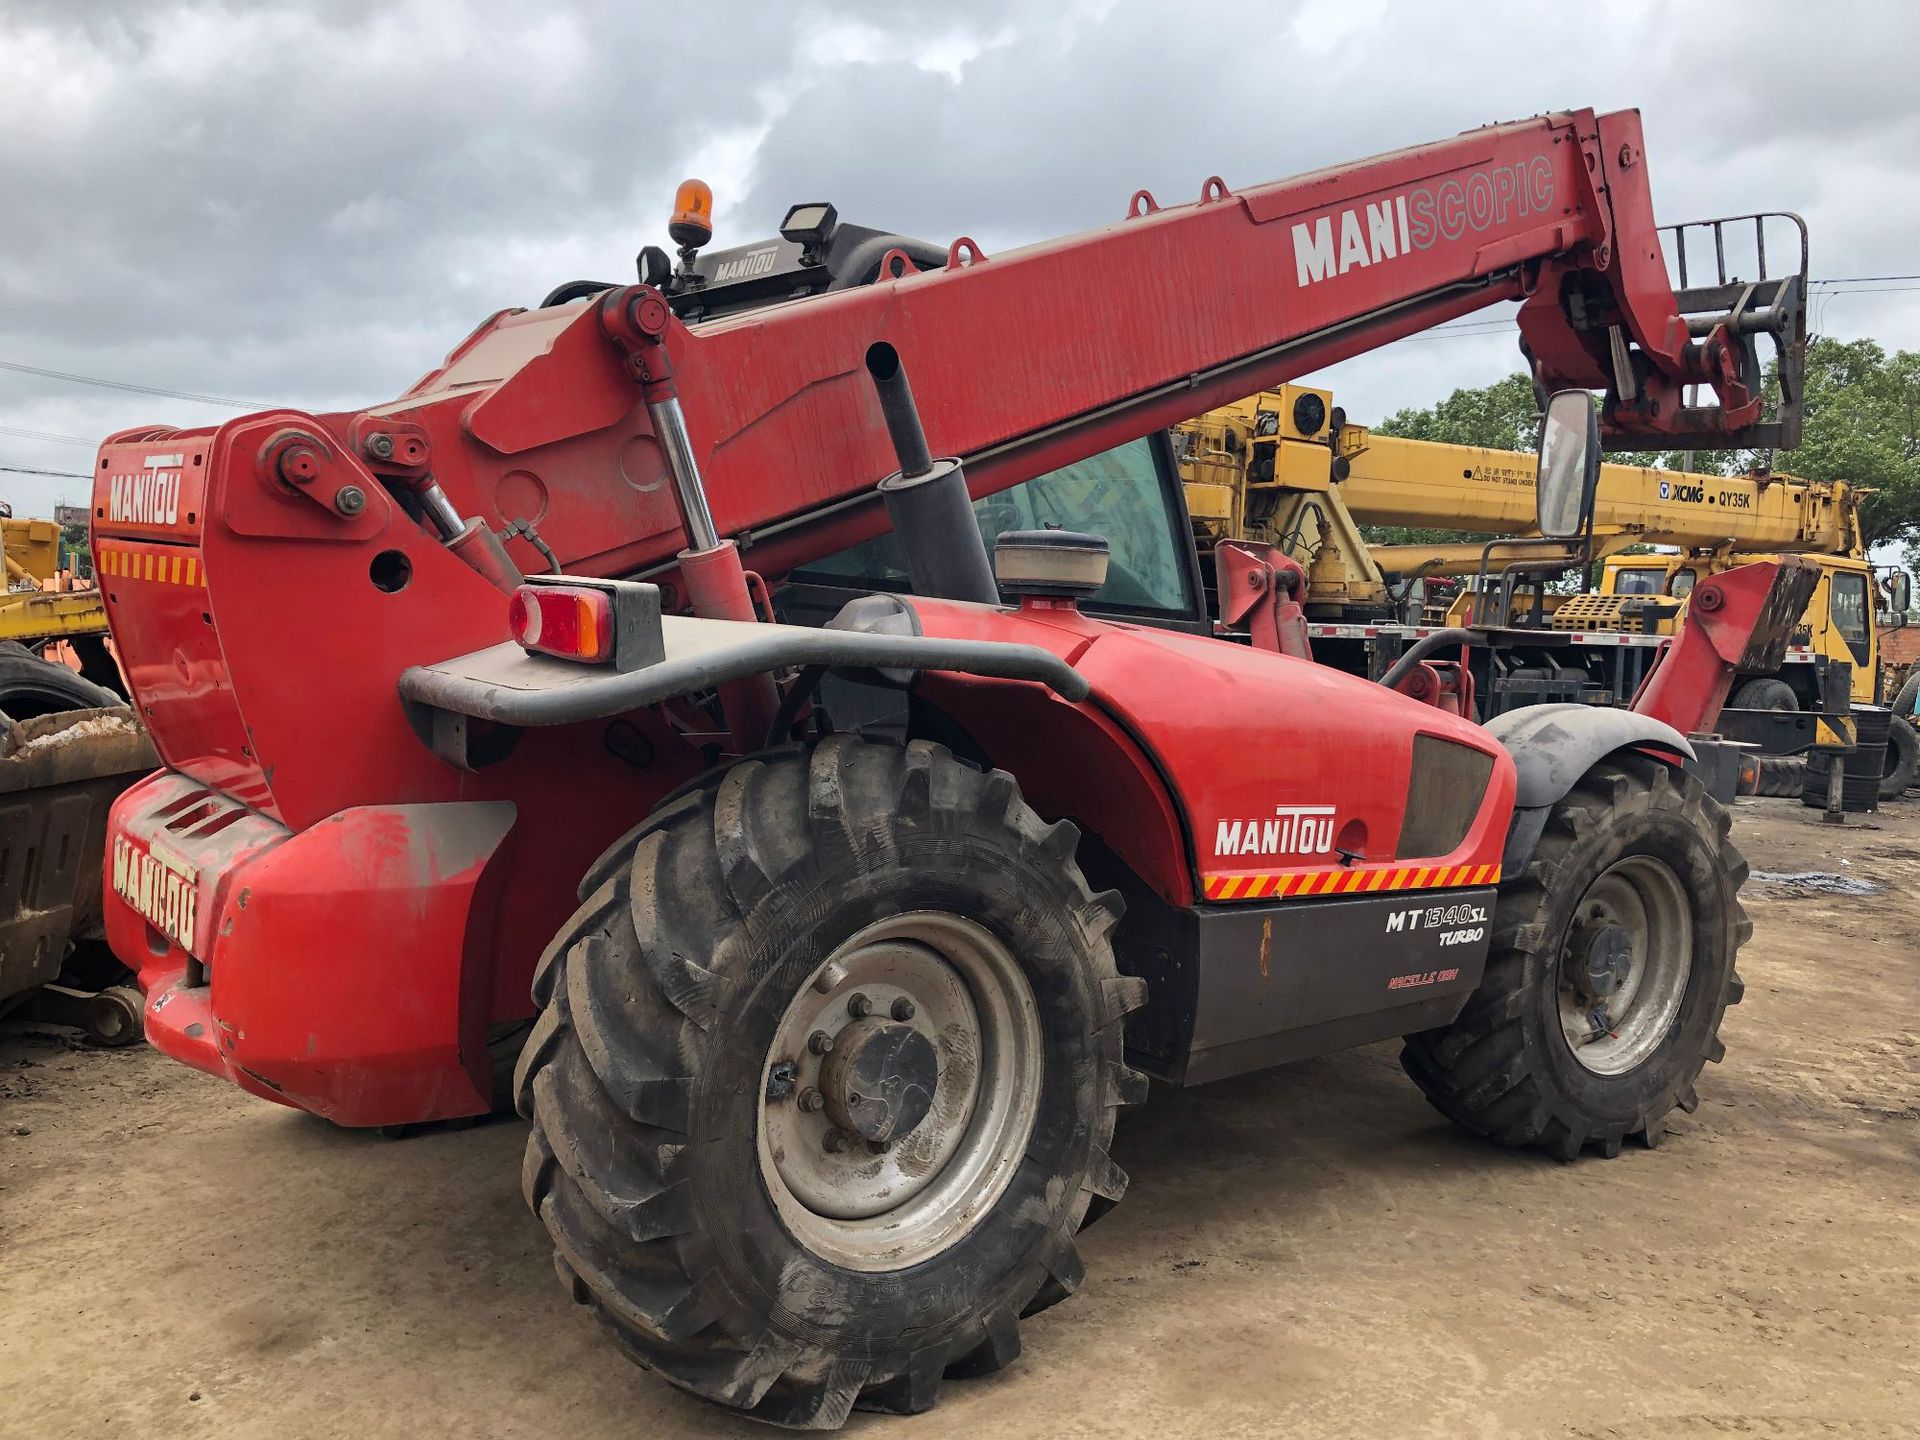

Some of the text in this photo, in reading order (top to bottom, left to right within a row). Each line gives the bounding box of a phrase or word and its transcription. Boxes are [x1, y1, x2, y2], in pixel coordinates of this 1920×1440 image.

[1291, 155, 1554, 288] MANISCOPIC
[713, 245, 779, 282] MANITOU
[109, 453, 184, 525] MANITOU
[1483, 474, 1490, 482] DO
[1518, 479, 1534, 487] UNDER
[1671, 484, 1750, 508] XCMG QY35K
[1214, 804, 1337, 856] MANITOU
[112, 833, 196, 952] MANITOU
[1439, 927, 1484, 946] TURBO
